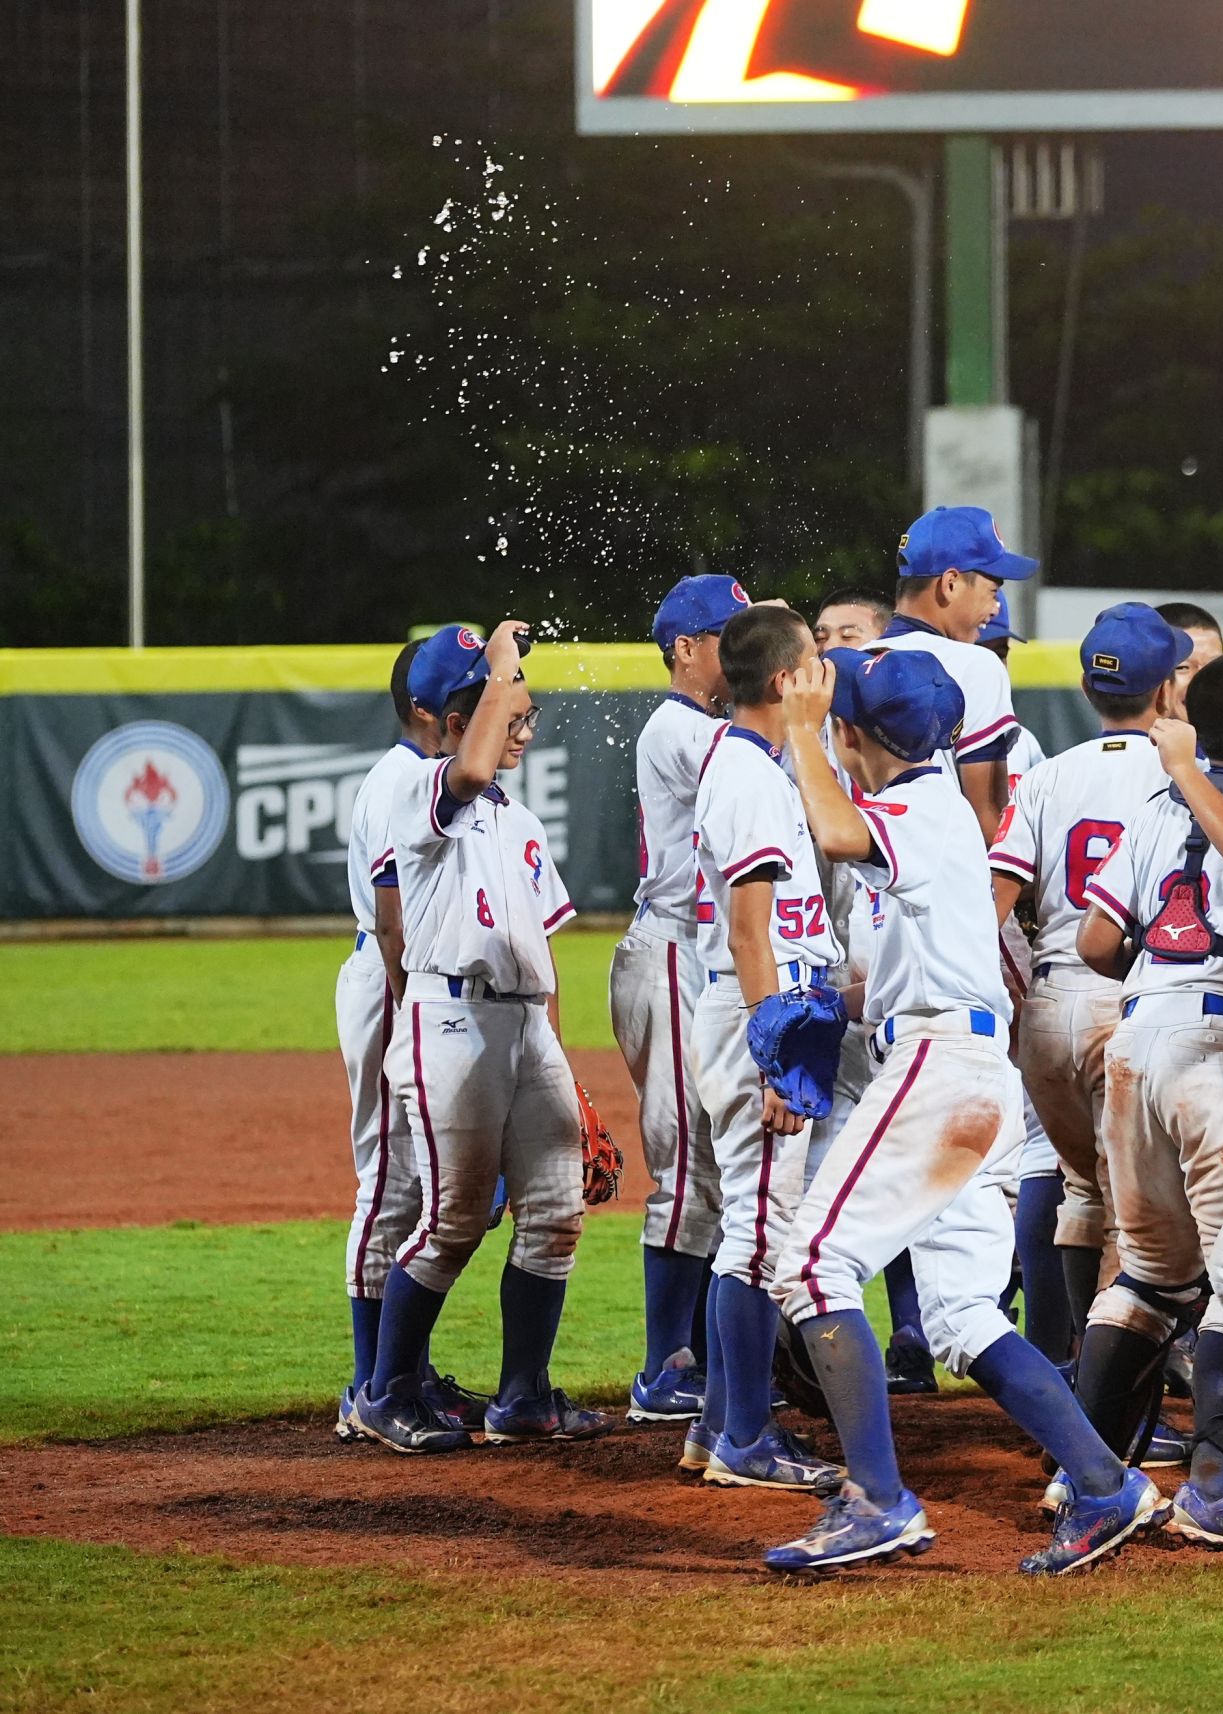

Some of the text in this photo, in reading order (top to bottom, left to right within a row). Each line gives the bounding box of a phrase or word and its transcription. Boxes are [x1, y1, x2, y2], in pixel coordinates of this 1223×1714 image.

[1065, 817, 1126, 911] 6
[476, 888, 495, 929] 8
[776, 894, 826, 940] 52
